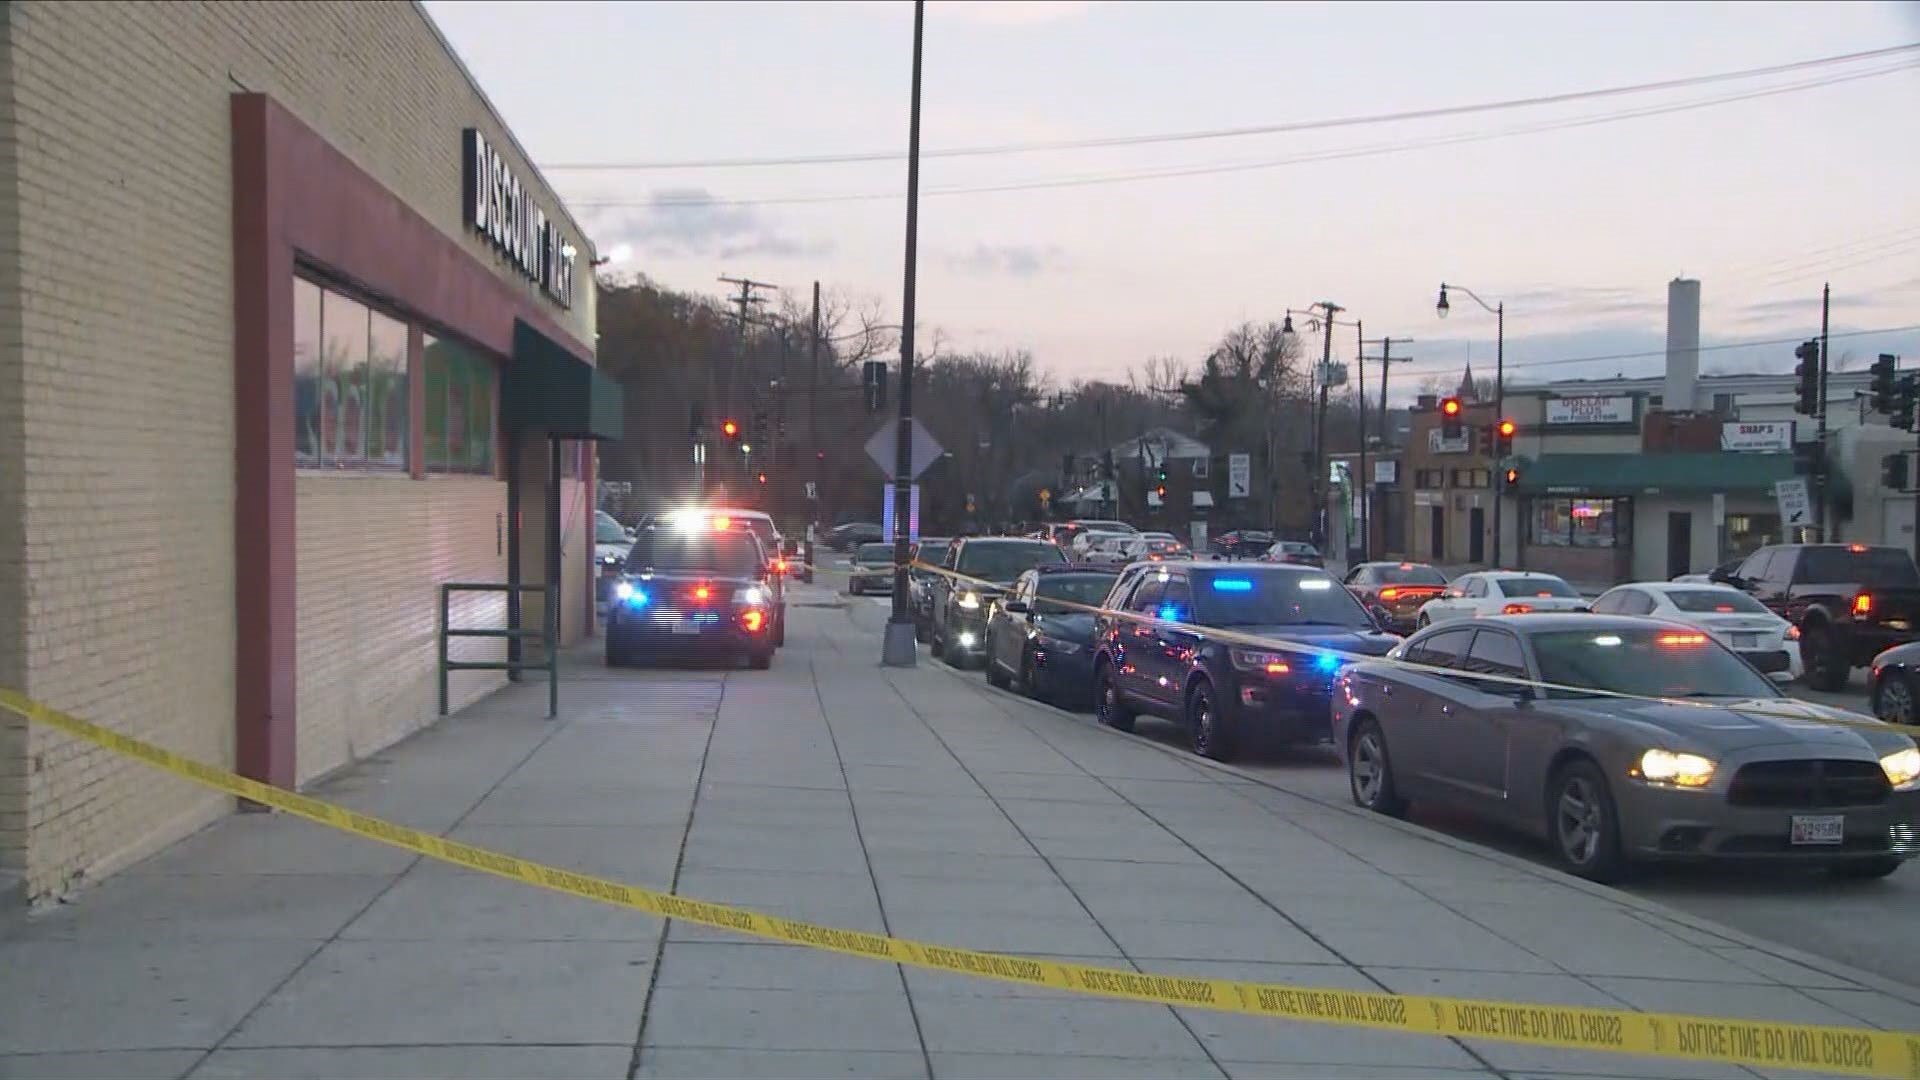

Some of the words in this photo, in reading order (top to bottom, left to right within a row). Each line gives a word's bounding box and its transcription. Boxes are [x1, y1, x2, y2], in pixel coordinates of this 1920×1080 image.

[476, 129, 545, 287] DISCOUNT
[1562, 397, 1611, 407] DOLLAR
[1571, 406, 1602, 415] PLUS
